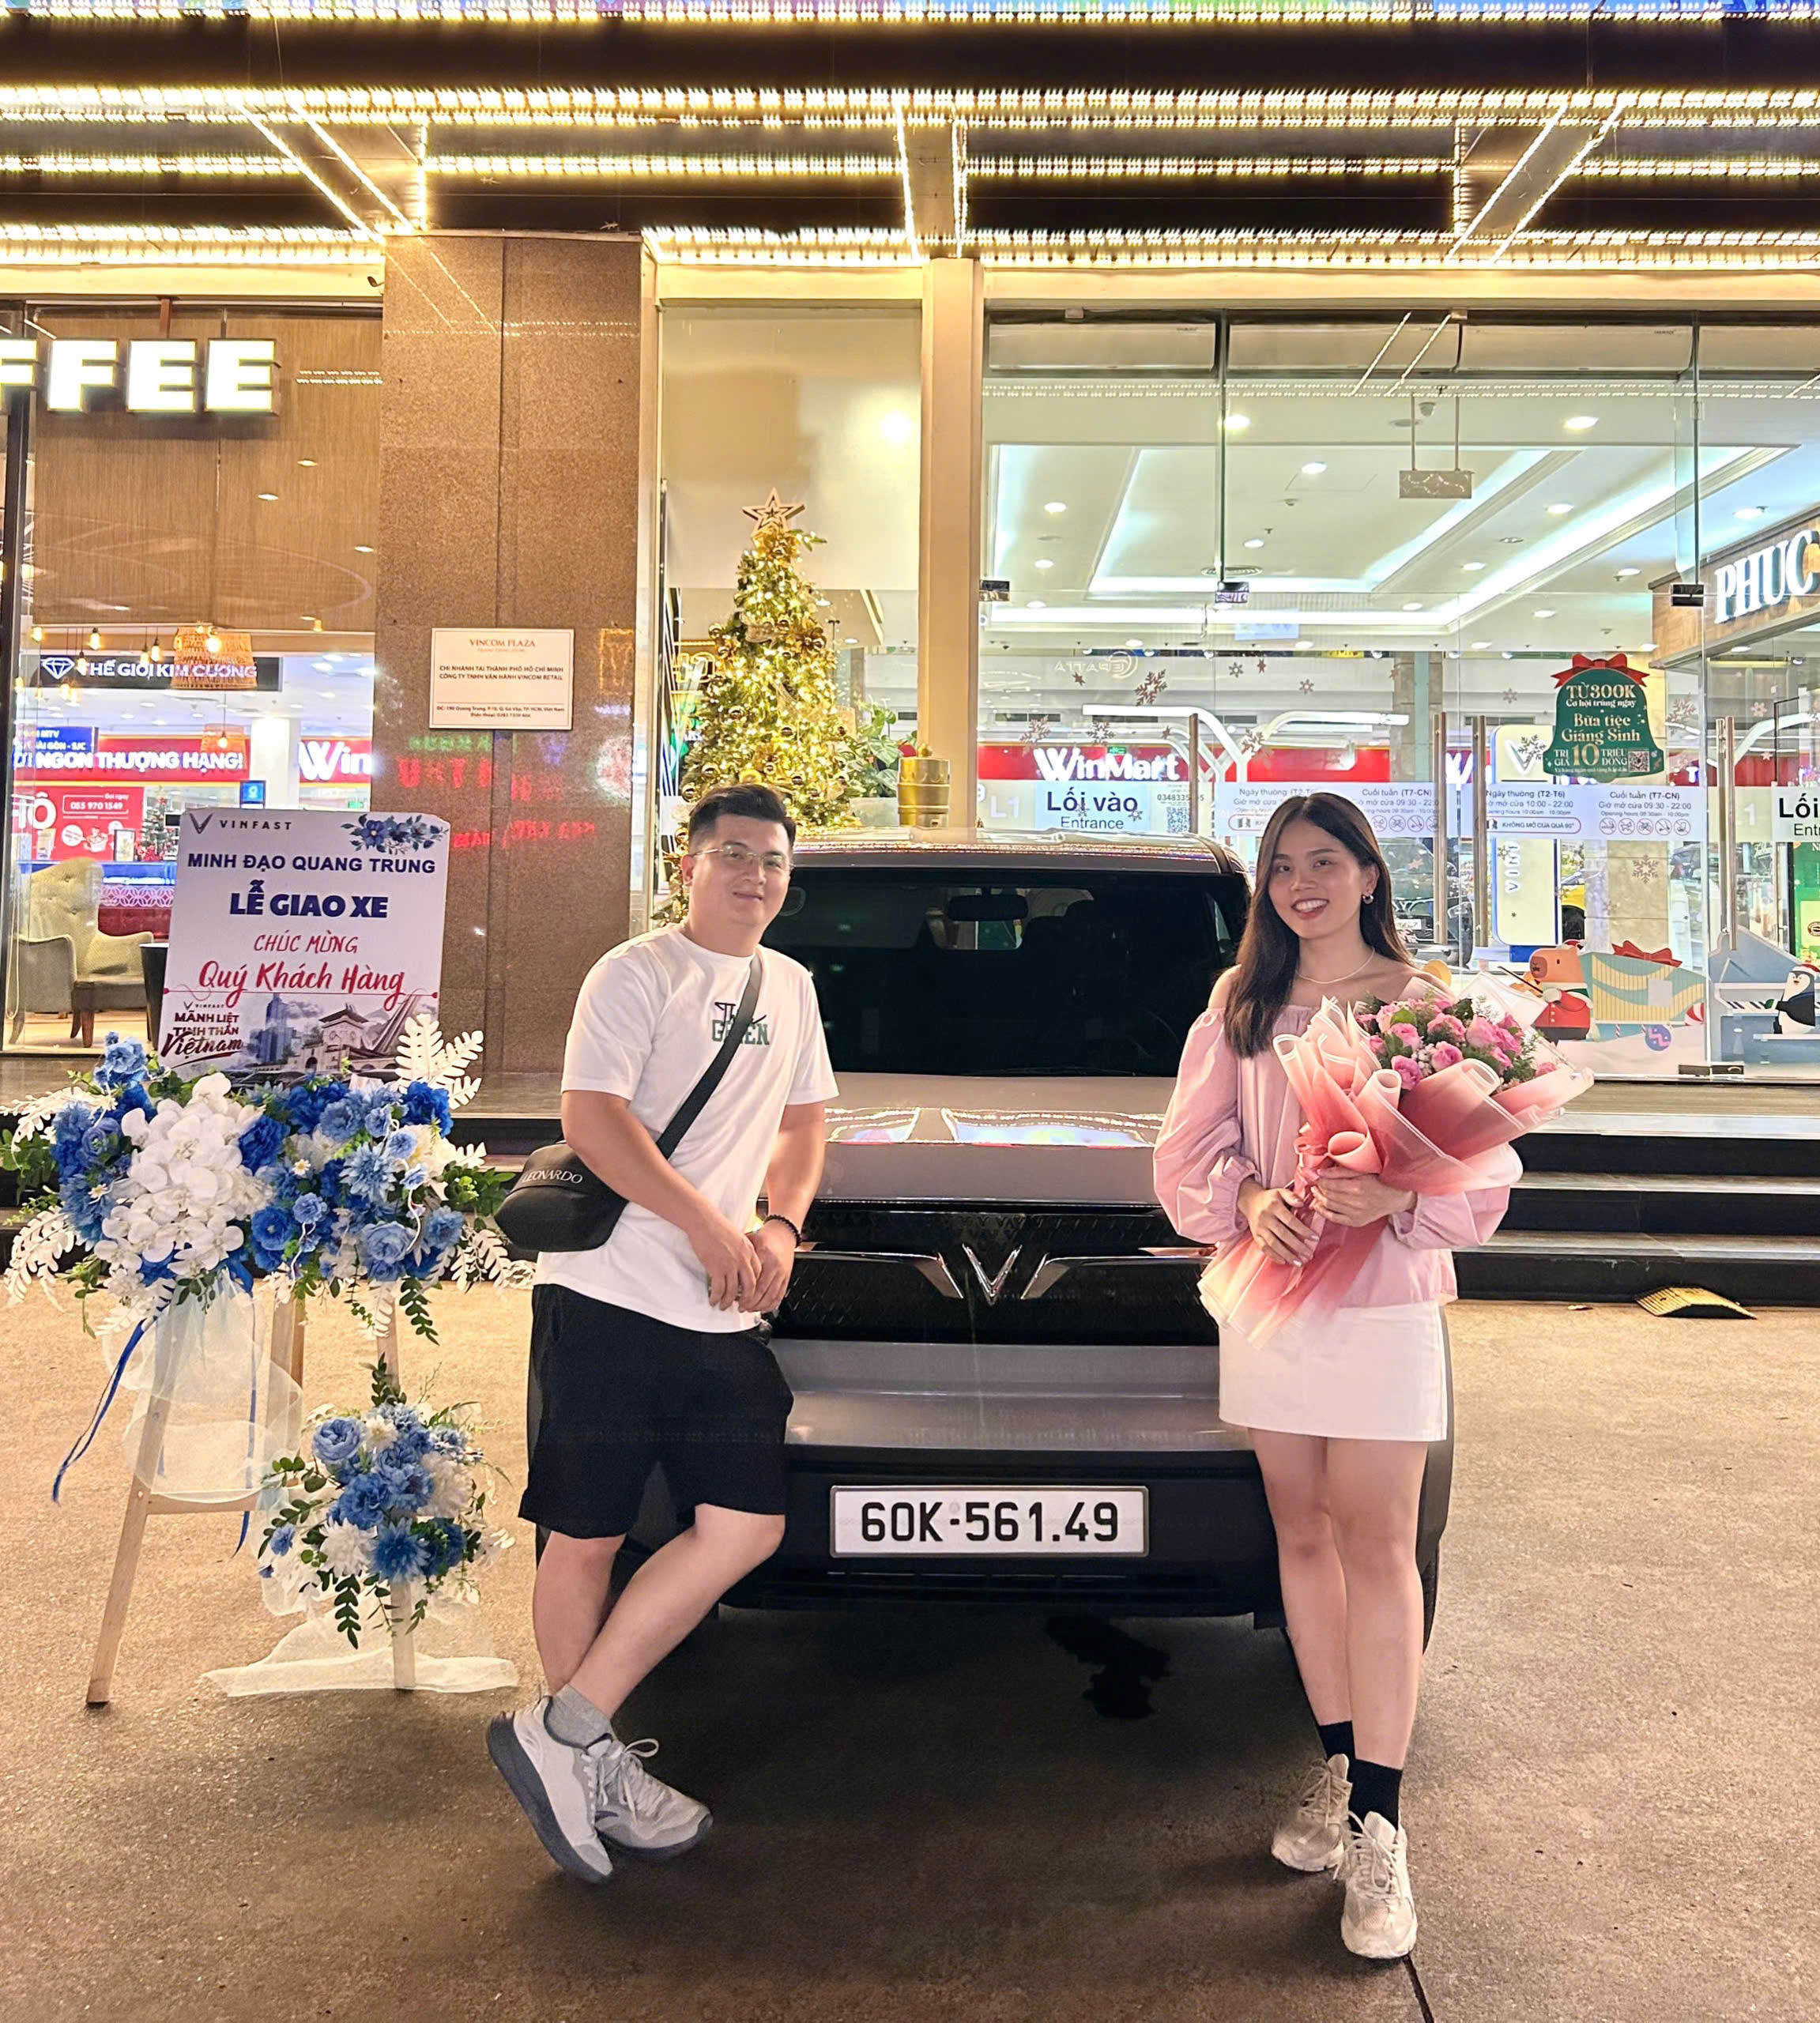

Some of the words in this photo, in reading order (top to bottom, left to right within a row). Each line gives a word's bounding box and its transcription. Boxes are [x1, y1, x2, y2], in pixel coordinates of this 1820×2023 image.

[469, 639, 505, 647] VINCOM
[507, 639, 536, 647] PLAZA
[1607, 727, 1641, 741] Sinh
[36, 751, 94, 770] NGON
[1033, 747, 1181, 782] WinMart
[1571, 743, 1600, 767] 10
[1047, 786, 1085, 812] Lối
[1093, 791, 1139, 812] vào
[219, 819, 292, 831] VINFAST
[1060, 816, 1124, 830] Entrance
[187, 853, 237, 869] MINH
[243, 854, 285, 872] ĐẠO
[292, 855, 363, 872] QUANG
[369, 857, 436, 874] TRUNG
[229, 879, 265, 916] LỄ
[269, 893, 345, 918] GIAO
[351, 895, 388, 918] XE
[253, 929, 301, 953] CHÚC
[305, 929, 359, 954] MỪNG
[198, 959, 250, 1008] Quý
[255, 961, 331, 992] Khách
[341, 963, 405, 1012] Hàng
[174, 1010, 215, 1023] MÃNH
[522, 1170, 583, 1185] LEONARDO
[861, 1501, 1119, 1543] 60K-561.49
